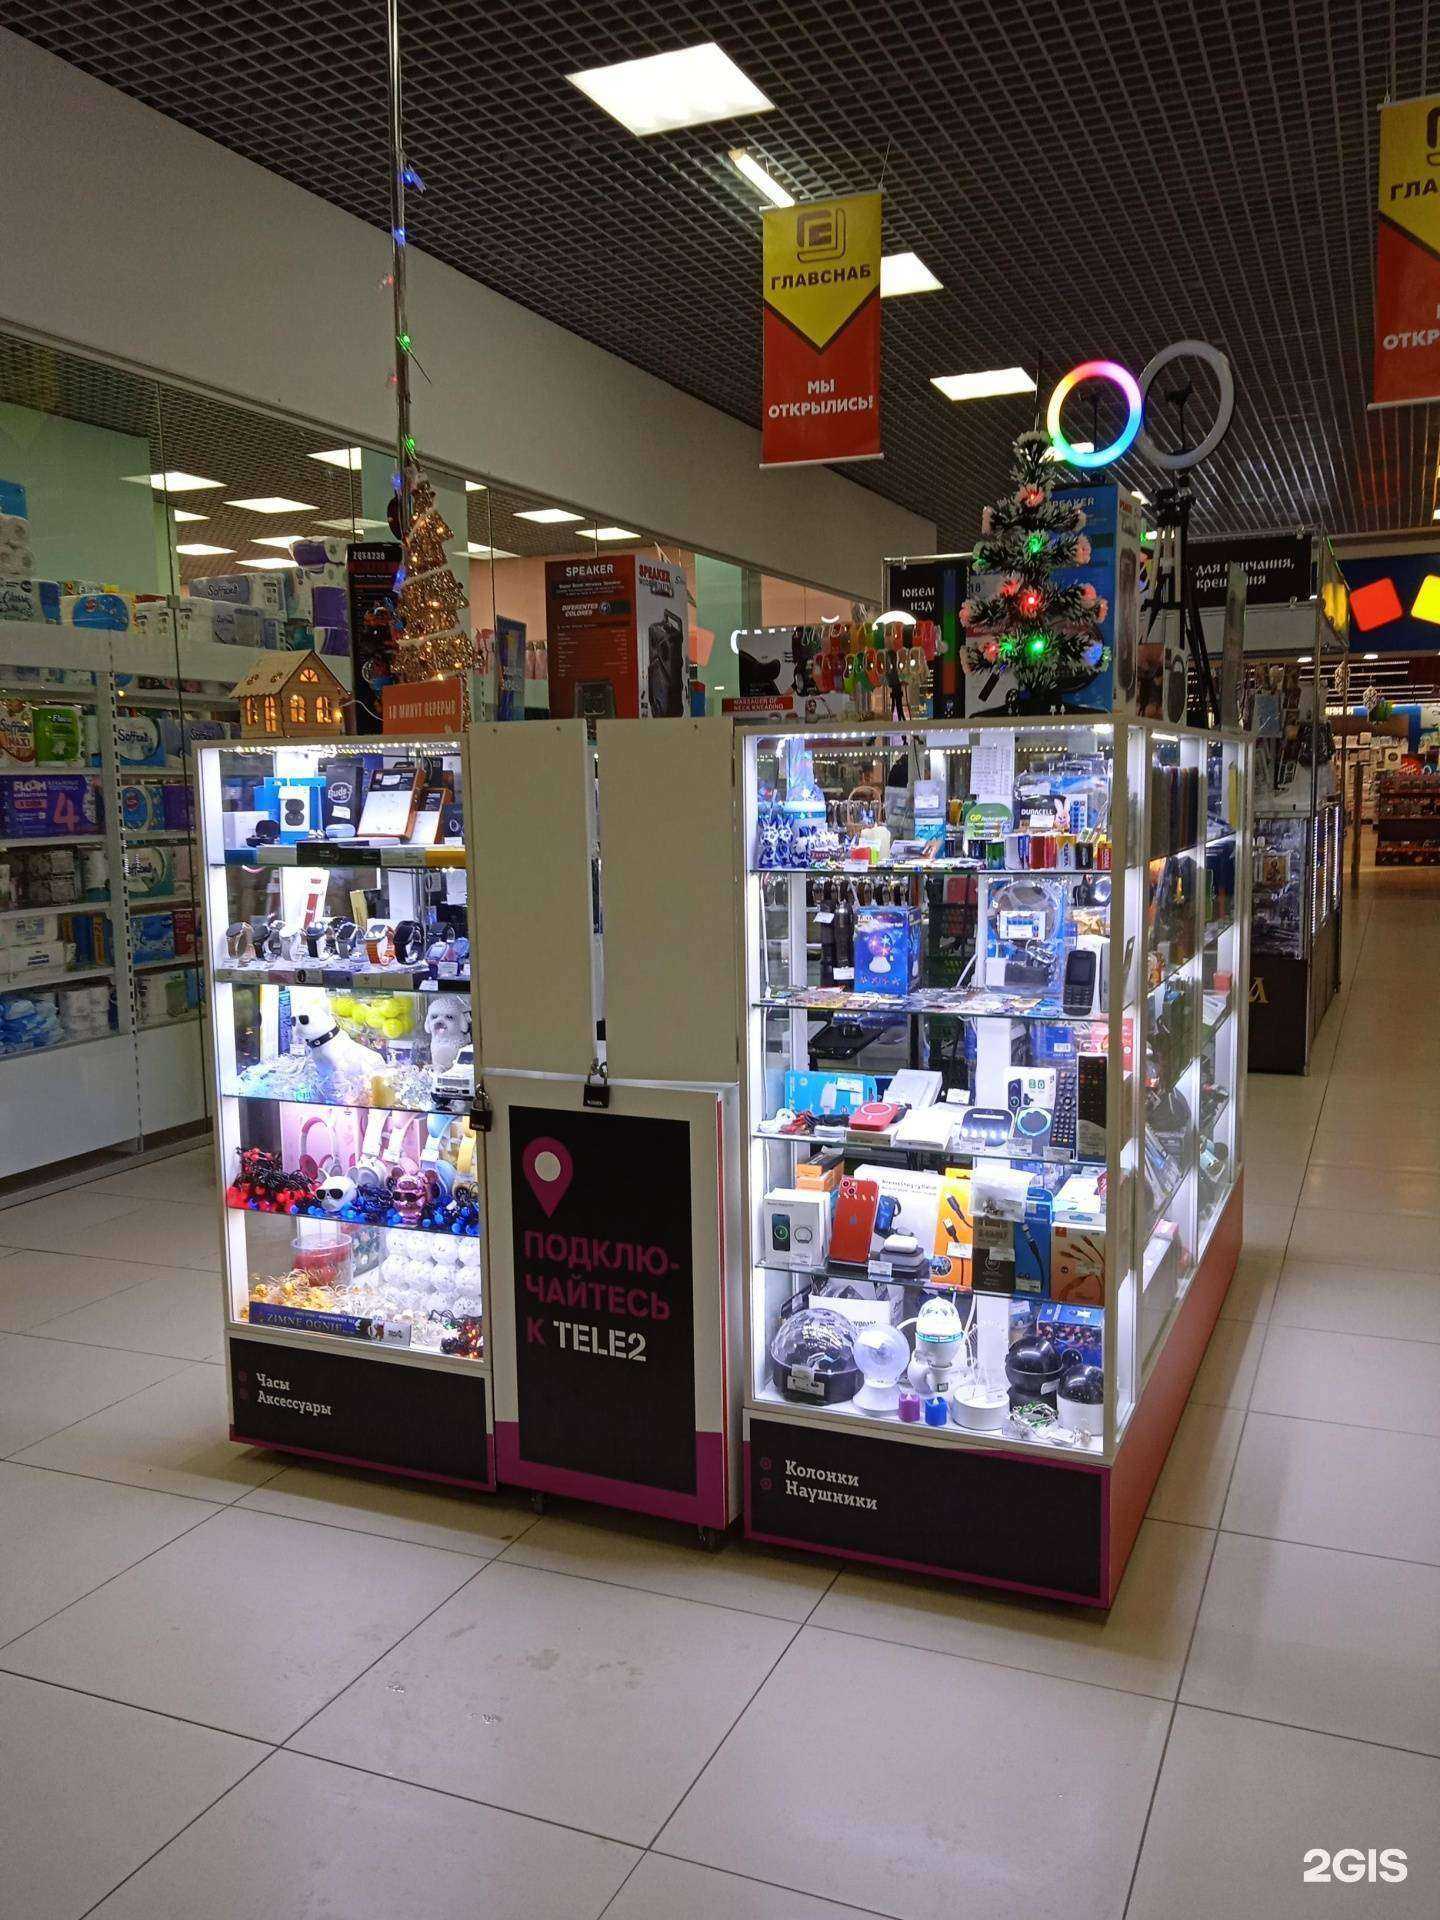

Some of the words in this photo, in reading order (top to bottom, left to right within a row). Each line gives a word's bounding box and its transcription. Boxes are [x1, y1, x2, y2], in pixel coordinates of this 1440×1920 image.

[771, 263, 871, 291] ГЛАВСНАБ
[807, 378, 836, 394] МЫ
[768, 395, 874, 418] ОТКРЫЛИСЬ!
[565, 564, 614, 577] SPEAKER
[1195, 563, 1220, 579] для
[1224, 558, 1296, 573] нчания,
[910, 601, 935, 612] изд
[53, 792, 80, 832] 4
[524, 1230, 680, 1276] ПОДКЛЮ-
[525, 1272, 671, 1321] ЧАЙТЕСЬ
[527, 1316, 546, 1345] К
[552, 1320, 647, 1362] TELE2
[255, 1372, 290, 1391] Часы
[257, 1390, 332, 1417] Аксессуары
[785, 1459, 859, 1488] Колонки
[785, 1479, 878, 1511] Наушники
